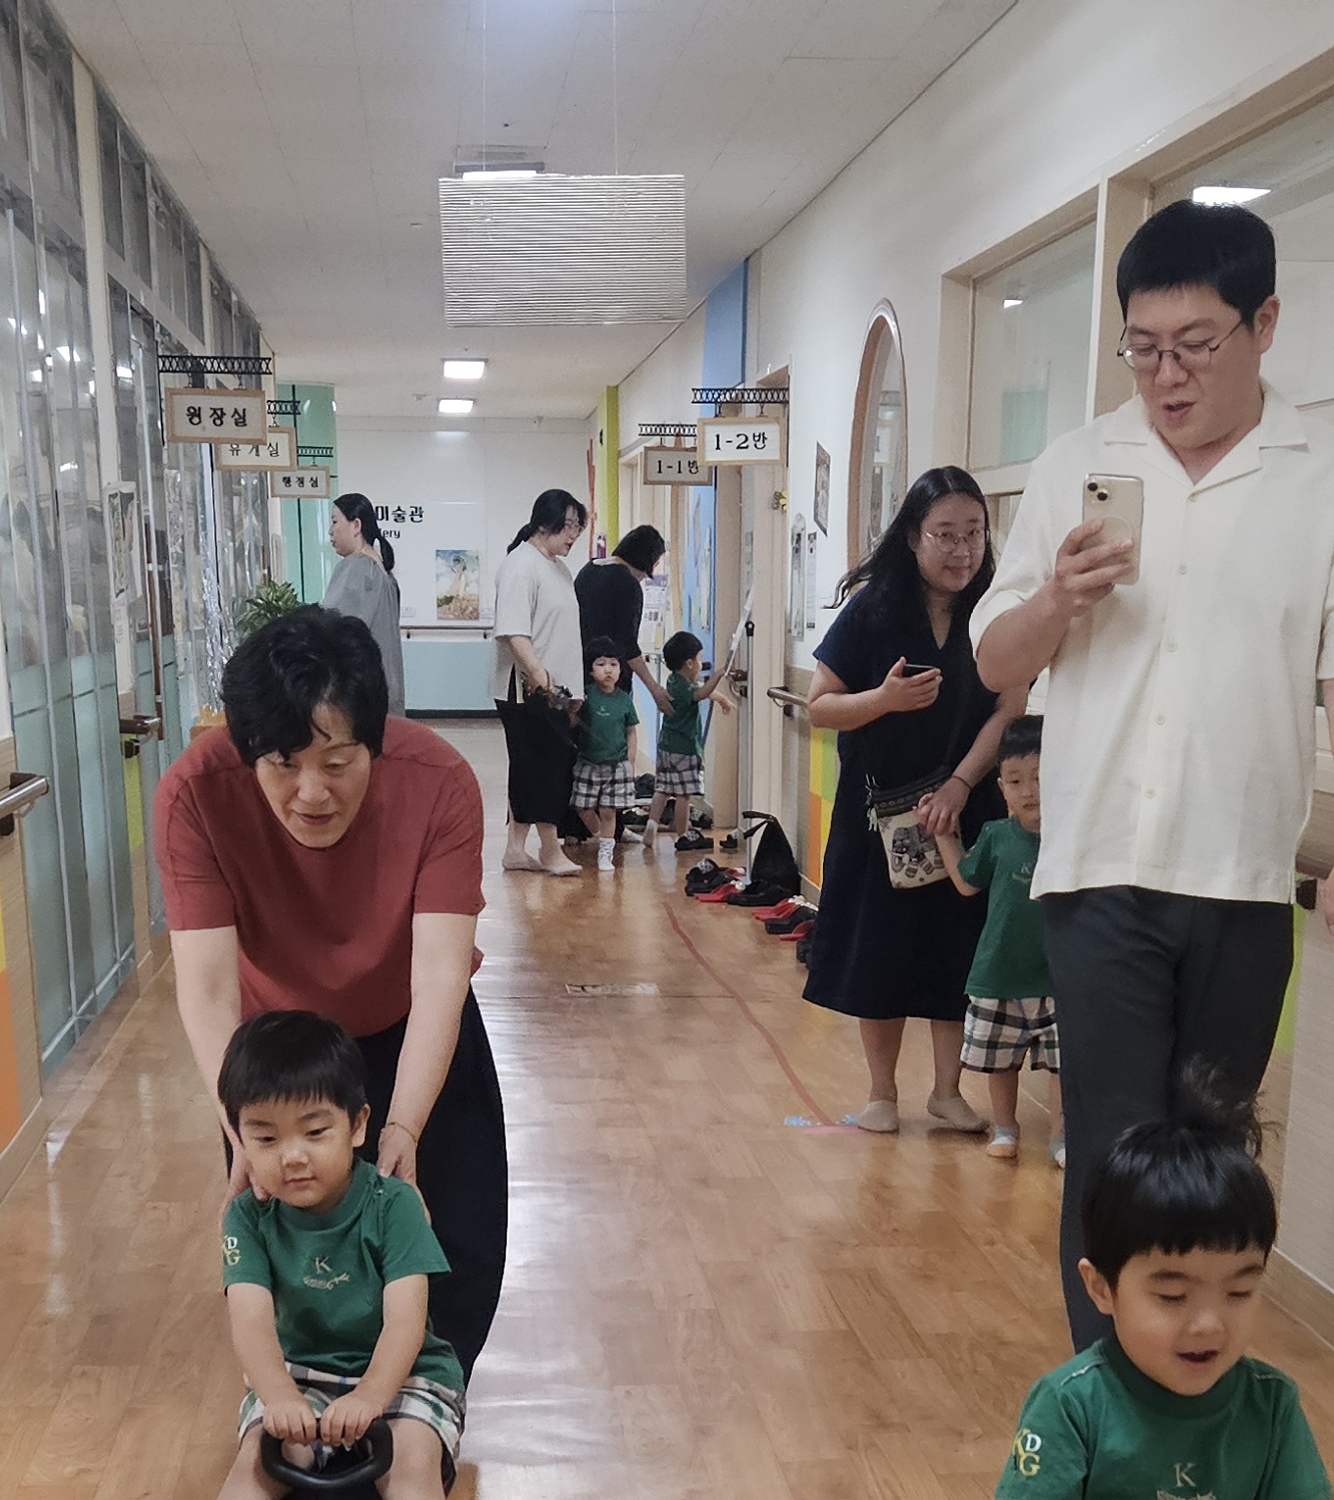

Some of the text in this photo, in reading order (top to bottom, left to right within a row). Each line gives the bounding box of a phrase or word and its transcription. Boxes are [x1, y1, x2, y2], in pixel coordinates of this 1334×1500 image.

[186, 406, 248, 427] 원장실
[715, 432, 768, 451] 1-2반
[657, 460, 699, 475] 1-1반
[375, 505, 424, 524] 미술관
[315, 1256, 333, 1274] K
[1173, 1461, 1197, 1488] K
